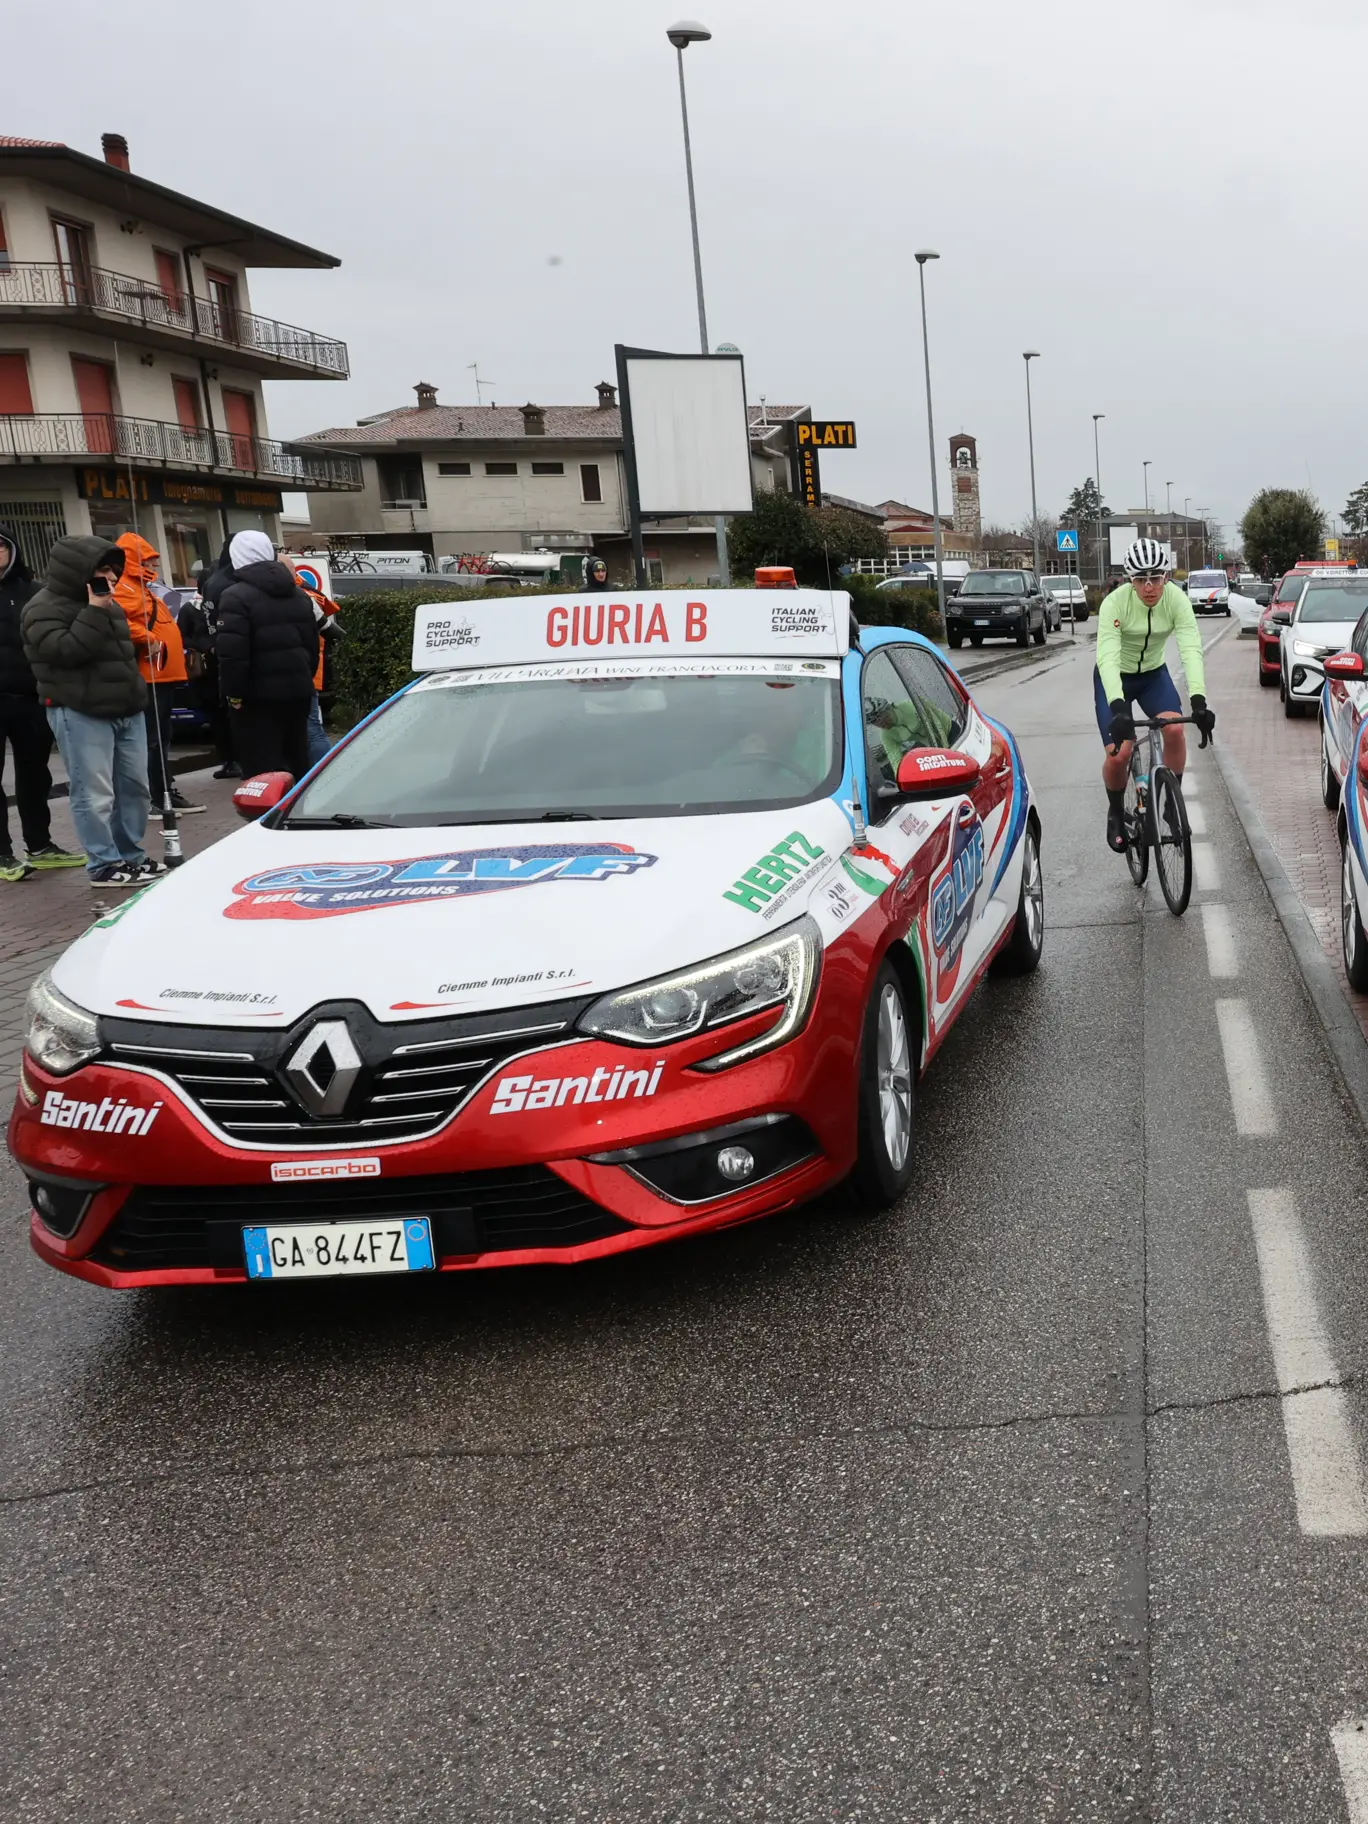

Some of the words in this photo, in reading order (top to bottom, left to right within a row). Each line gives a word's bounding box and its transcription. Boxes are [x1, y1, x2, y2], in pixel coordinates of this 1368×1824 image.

[798, 424, 854, 445] PLATI
[84, 468, 149, 500] PLATI
[771, 608, 816, 616] ITALIAN
[771, 616, 818, 624] CYCLING
[426, 628, 472, 639] CYCLING
[427, 621, 451, 630] PRO
[546, 603, 670, 648] GIURIA
[685, 602, 708, 642] B
[771, 625, 828, 633] SUPPORT
[425, 637, 480, 648] SUPPORT
[606, 666, 641, 675] WINE
[649, 664, 768, 673] FRANCIACORTA
[916, 754, 946, 764] CONTI
[919, 759, 967, 772] SALDATURE
[391, 854, 647, 882] LVF
[722, 830, 825, 913] HERTZ
[252, 893, 324, 904] VALVE
[328, 886, 460, 902] SOLUTIONS
[437, 980, 488, 994] Ciemme
[491, 972, 543, 986] Impianti
[546, 969, 576, 980] S.r.l.
[159, 988, 202, 999] Ciemme
[204, 990, 249, 1002] Impianti
[250, 993, 277, 1005] S.r.l.
[489, 1060, 667, 1115] Santini
[41, 1091, 164, 1137] Santini
[272, 1162, 378, 1180] isocarbo
